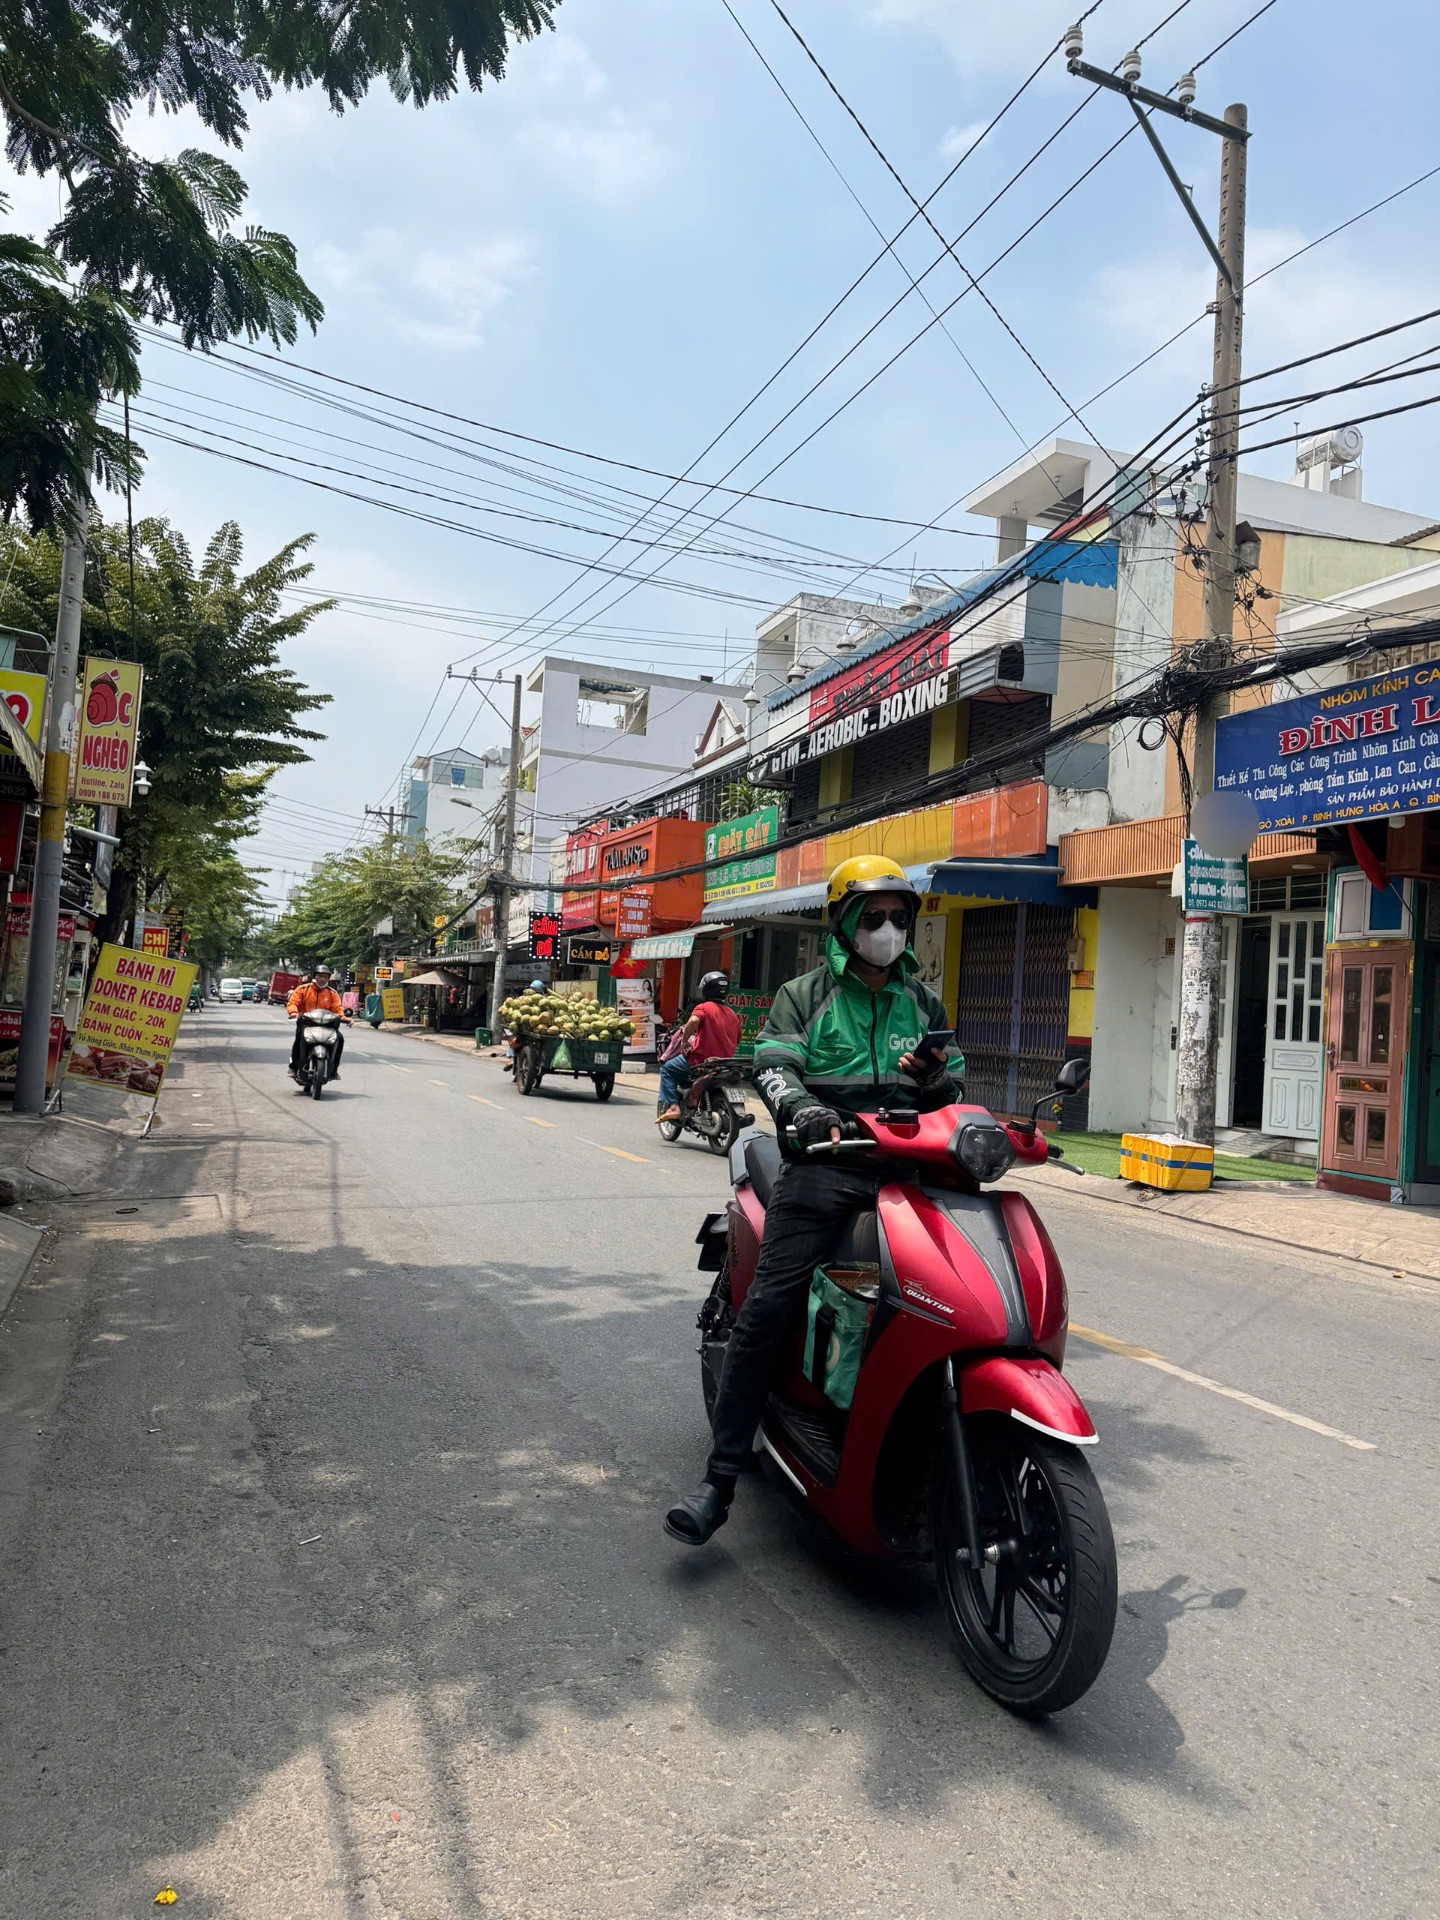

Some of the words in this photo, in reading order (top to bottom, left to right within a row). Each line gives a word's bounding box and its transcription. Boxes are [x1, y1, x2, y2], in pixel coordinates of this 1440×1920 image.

[1320, 687, 1368, 711] NHÔM
[1372, 676, 1409, 698] KÍNH
[807, 707, 870, 759] AEROBIC
[879, 671, 949, 730] BOXING
[1278, 704, 1399, 756] ĐÌNH
[82, 730, 130, 773] NGHÈO
[1238, 767, 1249, 784] Kế
[1268, 763, 1287, 780] Công
[1290, 757, 1305, 773] Các
[1309, 754, 1330, 772] Công
[1333, 747, 1358, 765] Trình
[1362, 742, 1389, 760] Nhôm
[1392, 734, 1416, 753] Kính
[1420, 729, 1439, 747] Cửa
[78, 788, 97, 799] 0909
[111, 791, 126, 801] 675
[81, 776, 108, 789] Hotline,
[109, 780, 125, 790] Zalo
[1299, 777, 1324, 796] phòng
[1326, 770, 1345, 788] Tắm
[1374, 765, 1393, 780] Lan
[1326, 791, 1346, 806] SẢN
[1348, 784, 1376, 803] PHẨM
[1379, 782, 1399, 797] BẢO
[1401, 778, 1432, 793] HÀNH
[1258, 818, 1273, 830] GÒ
[1274, 815, 1296, 828] XOÀI
[1312, 810, 1333, 823] BÌNH
[1335, 805, 1364, 819] HƯNG
[1368, 800, 1390, 813] HÒA
[114, 956, 155, 983] BÁNH
[155, 966, 176, 988] MÌ
[92, 977, 138, 1004] DONER
[138, 988, 183, 1014] KEBAB
[88, 1000, 111, 1016] TAM
[112, 1006, 138, 1022] GIÁC
[145, 1014, 167, 1029] 20K
[82, 1016, 112, 1034] BÁNH
[113, 1024, 143, 1042] CUỘN
[150, 1033, 173, 1049] 25K
[906, 1289, 955, 1314] QUANTUM
